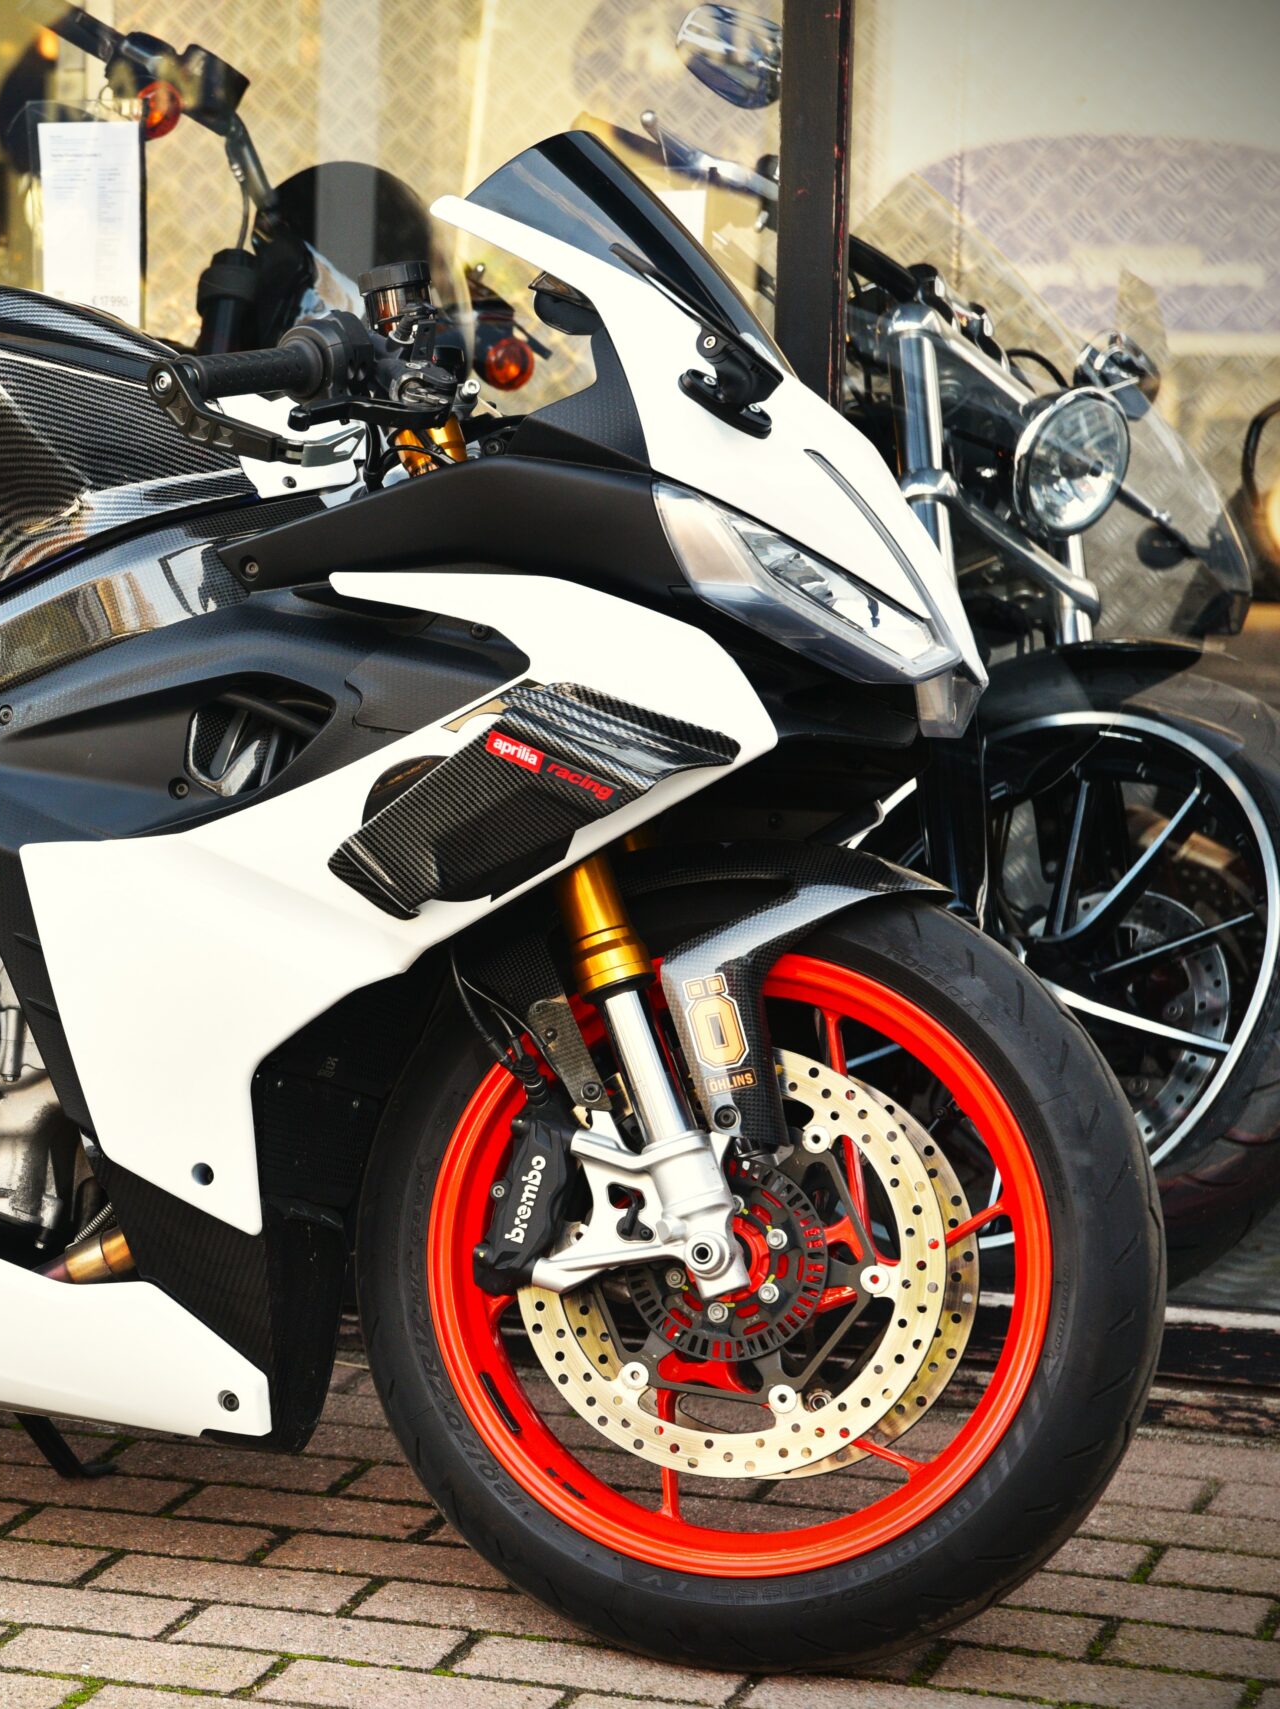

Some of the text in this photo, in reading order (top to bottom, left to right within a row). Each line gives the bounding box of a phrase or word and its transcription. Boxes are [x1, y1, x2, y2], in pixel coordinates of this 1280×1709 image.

[492, 736, 615, 801] aprilia racing
[709, 1072, 754, 1093] ÖHLINS
[504, 1155, 547, 1245] brembo
